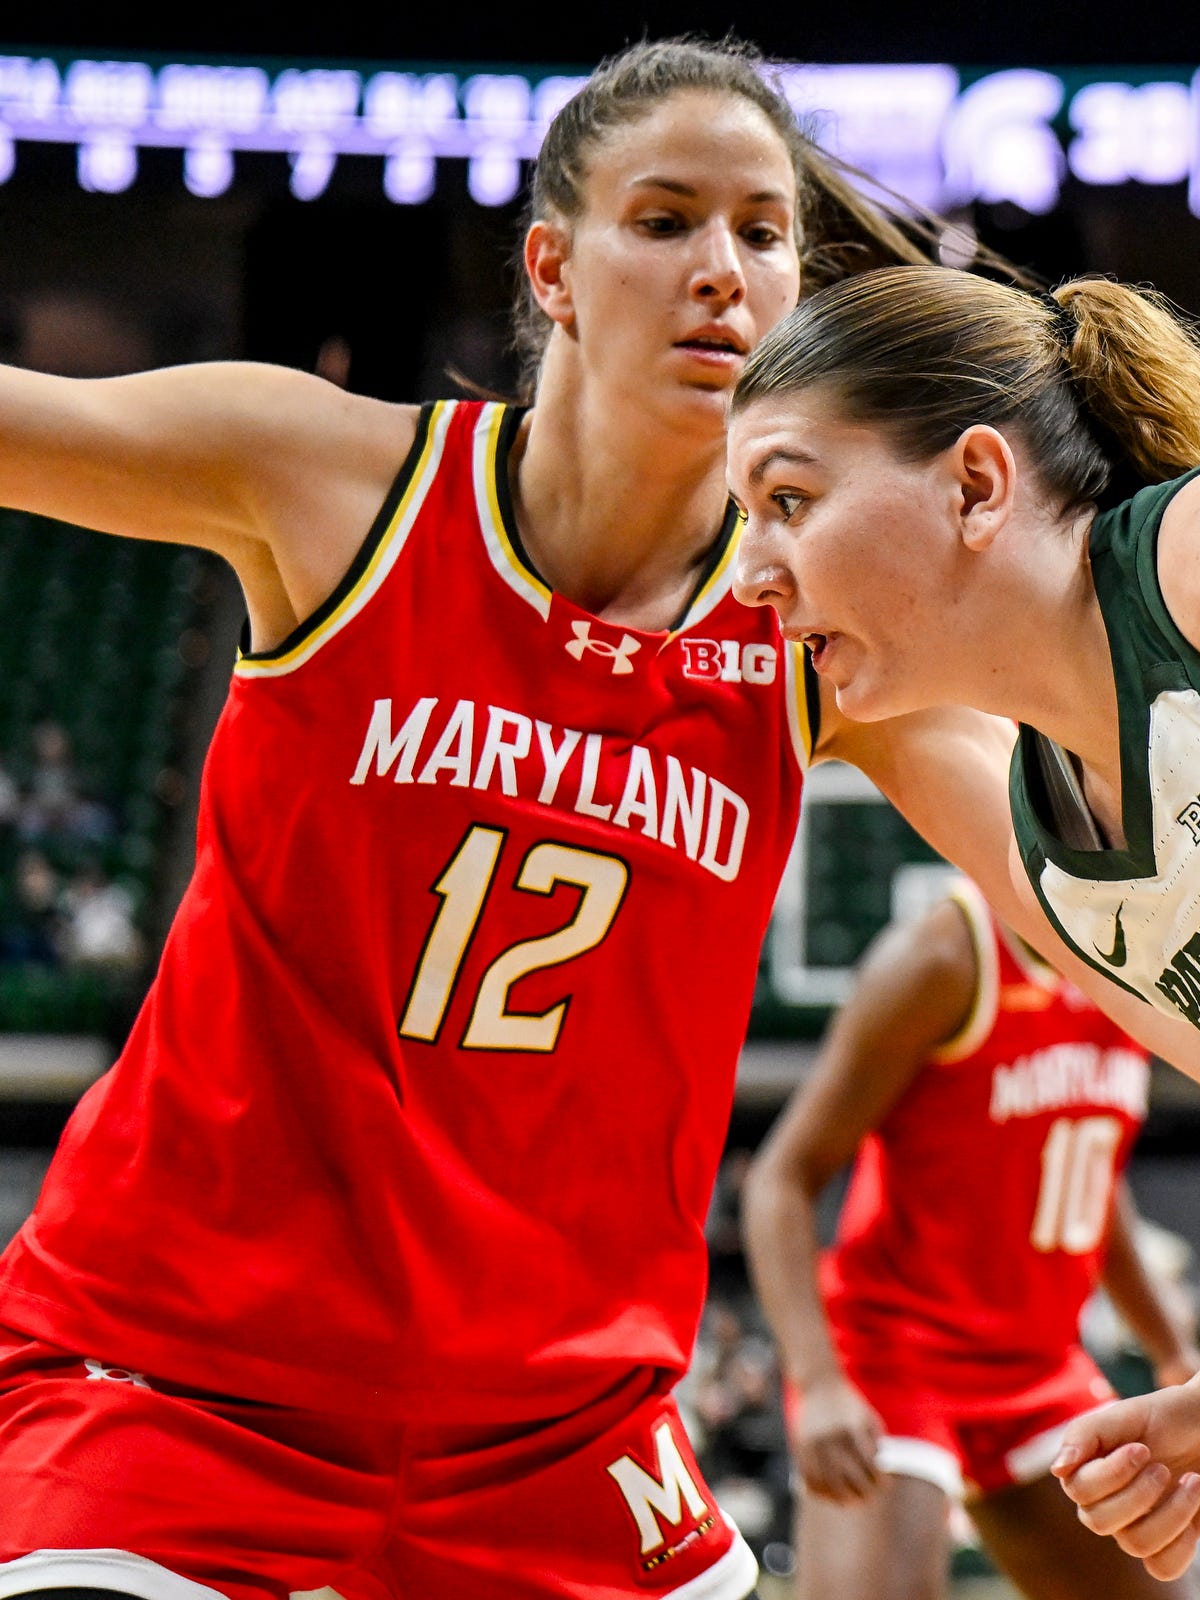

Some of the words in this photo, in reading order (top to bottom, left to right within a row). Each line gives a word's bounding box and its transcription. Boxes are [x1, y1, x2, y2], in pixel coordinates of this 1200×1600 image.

[349, 697, 750, 883] MARYLAND
[398, 821, 632, 1053] 12
[1029, 1115, 1124, 1256] 10
[606, 1421, 709, 1556] M
